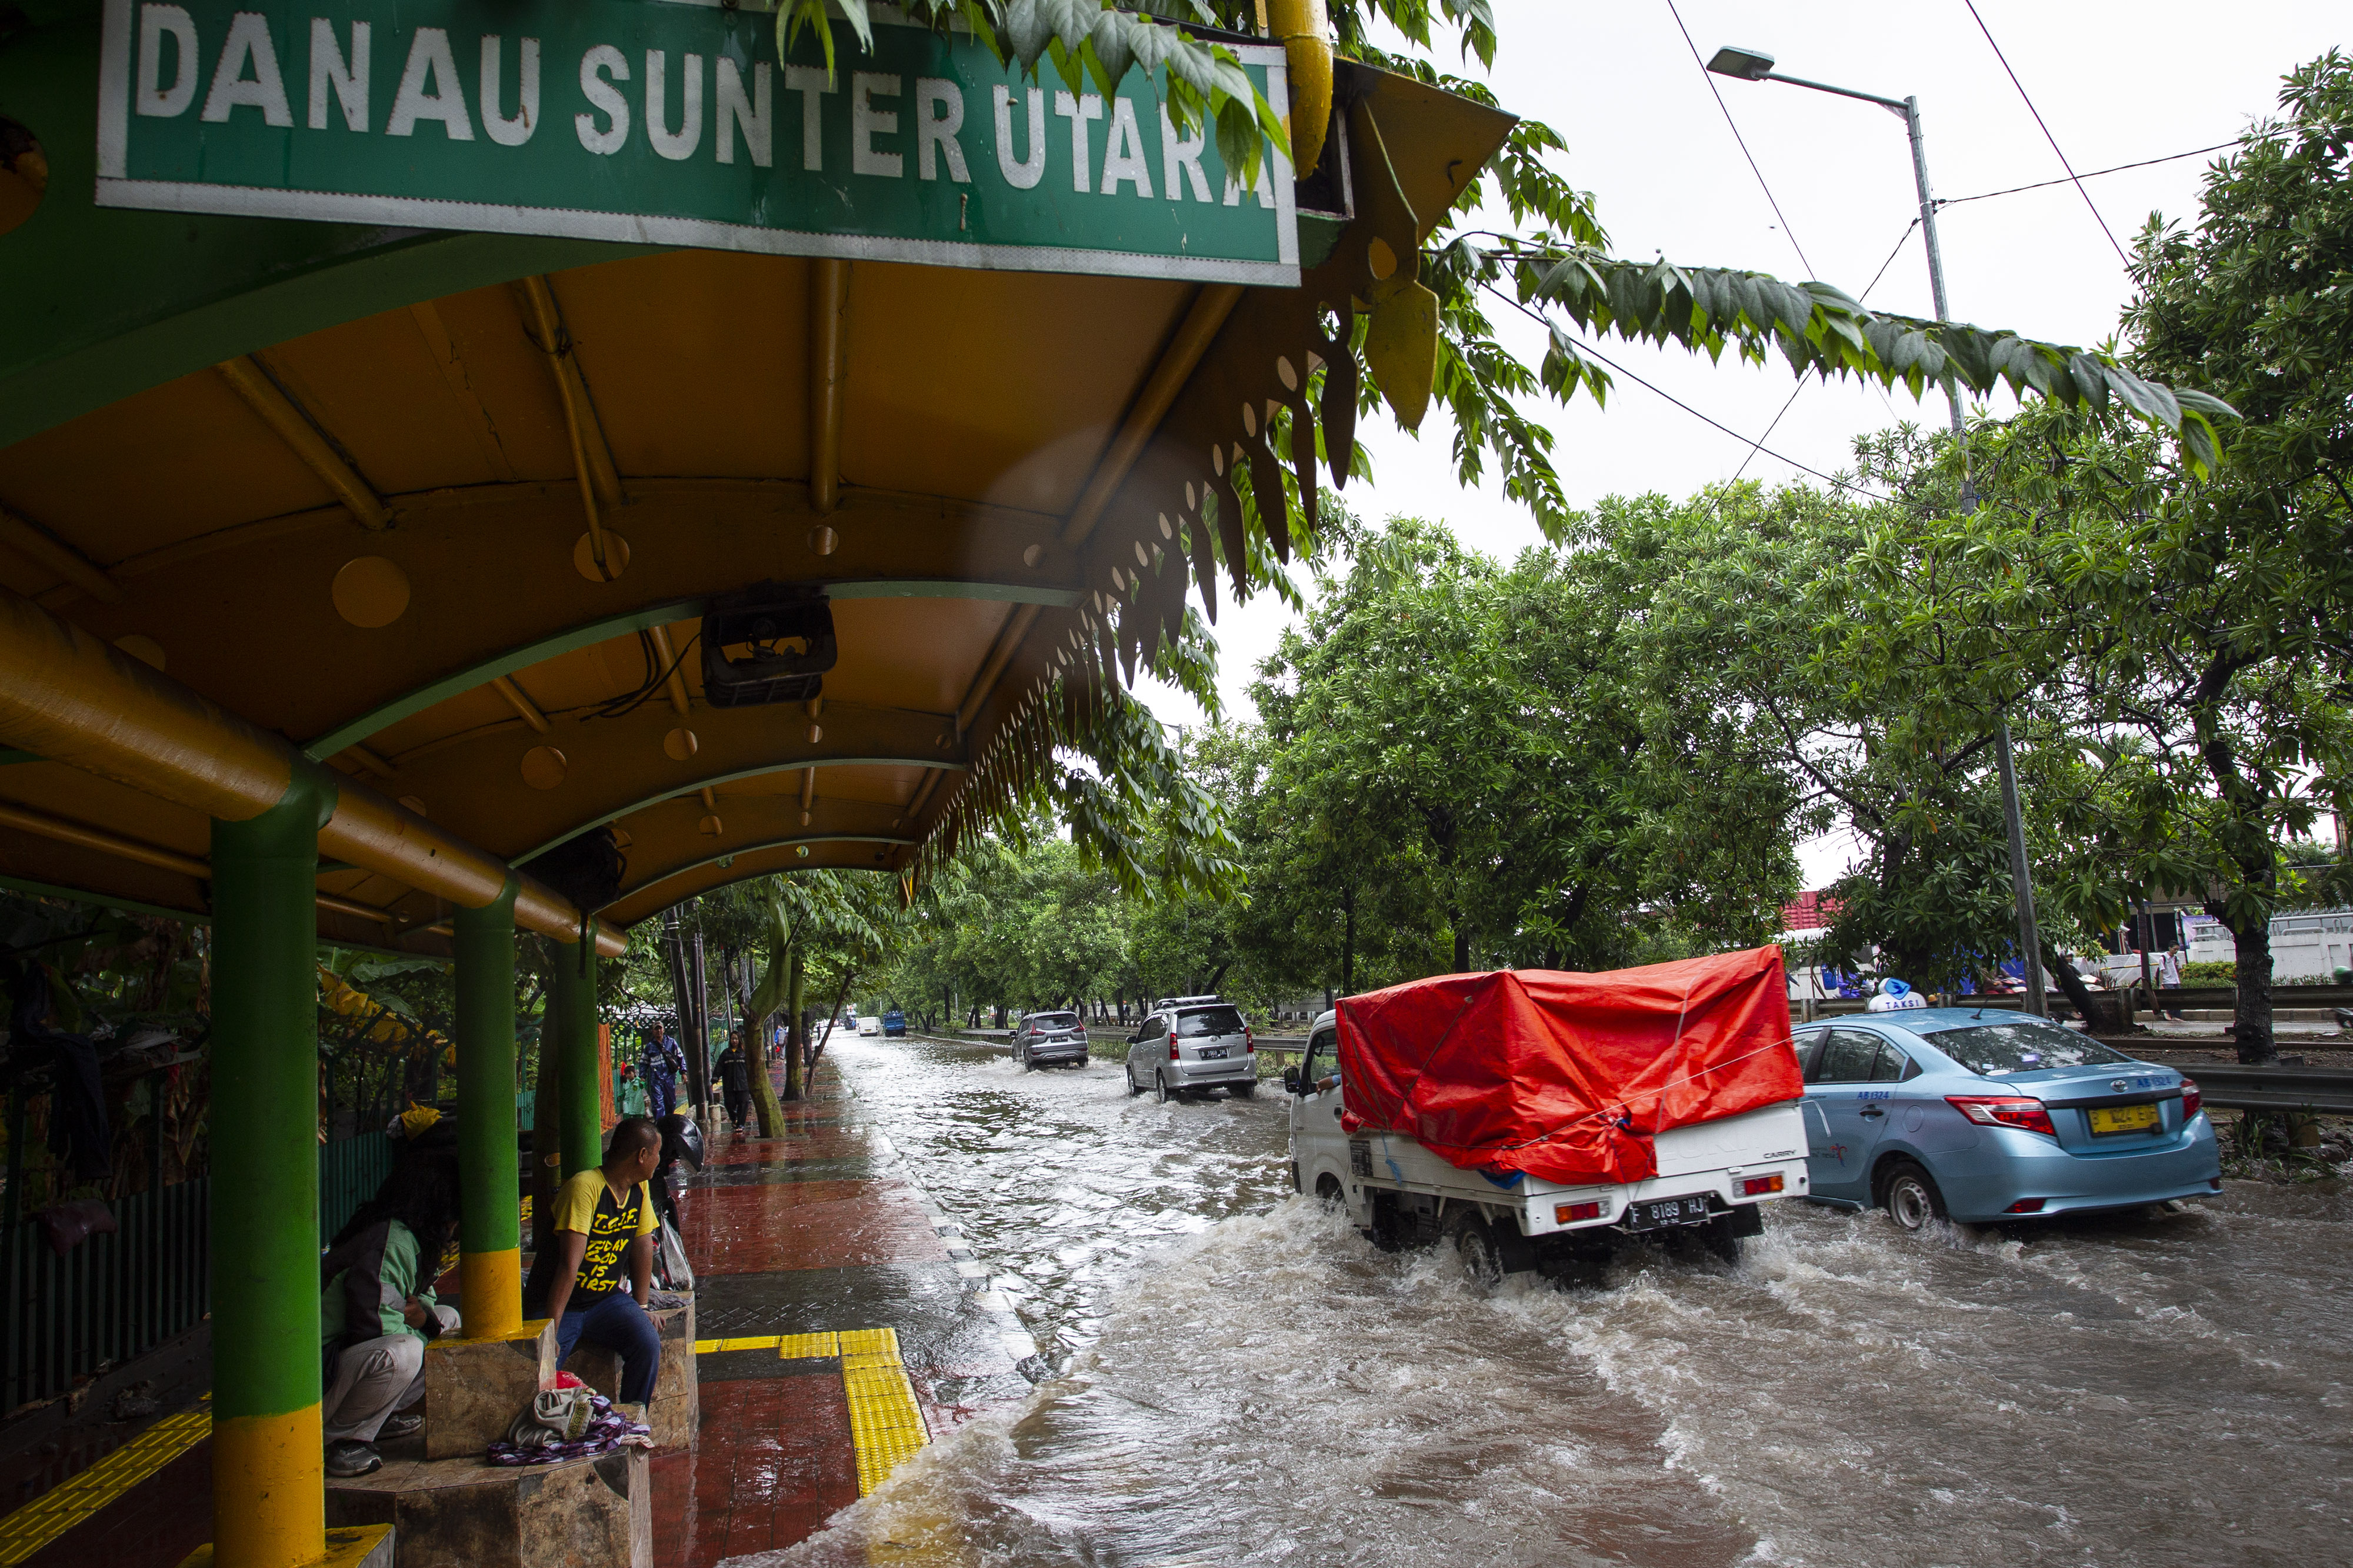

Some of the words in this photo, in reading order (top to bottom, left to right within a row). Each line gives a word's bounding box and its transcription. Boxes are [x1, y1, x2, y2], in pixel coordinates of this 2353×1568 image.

[136, 3, 539, 146] DANAU
[575, 45, 972, 184] SUNTER
[1885, 1000, 1919, 1009] TAKSI
[1870, 1091, 1889, 1099] 1324
[1764, 1149, 1797, 1159] CARRY
[1651, 1202, 1680, 1219] 8189
[1688, 1197, 1704, 1213] HJ
[587, 1238, 629, 1252] TODAY
[585, 1250, 617, 1265] GOD
[591, 1265, 608, 1277] IS
